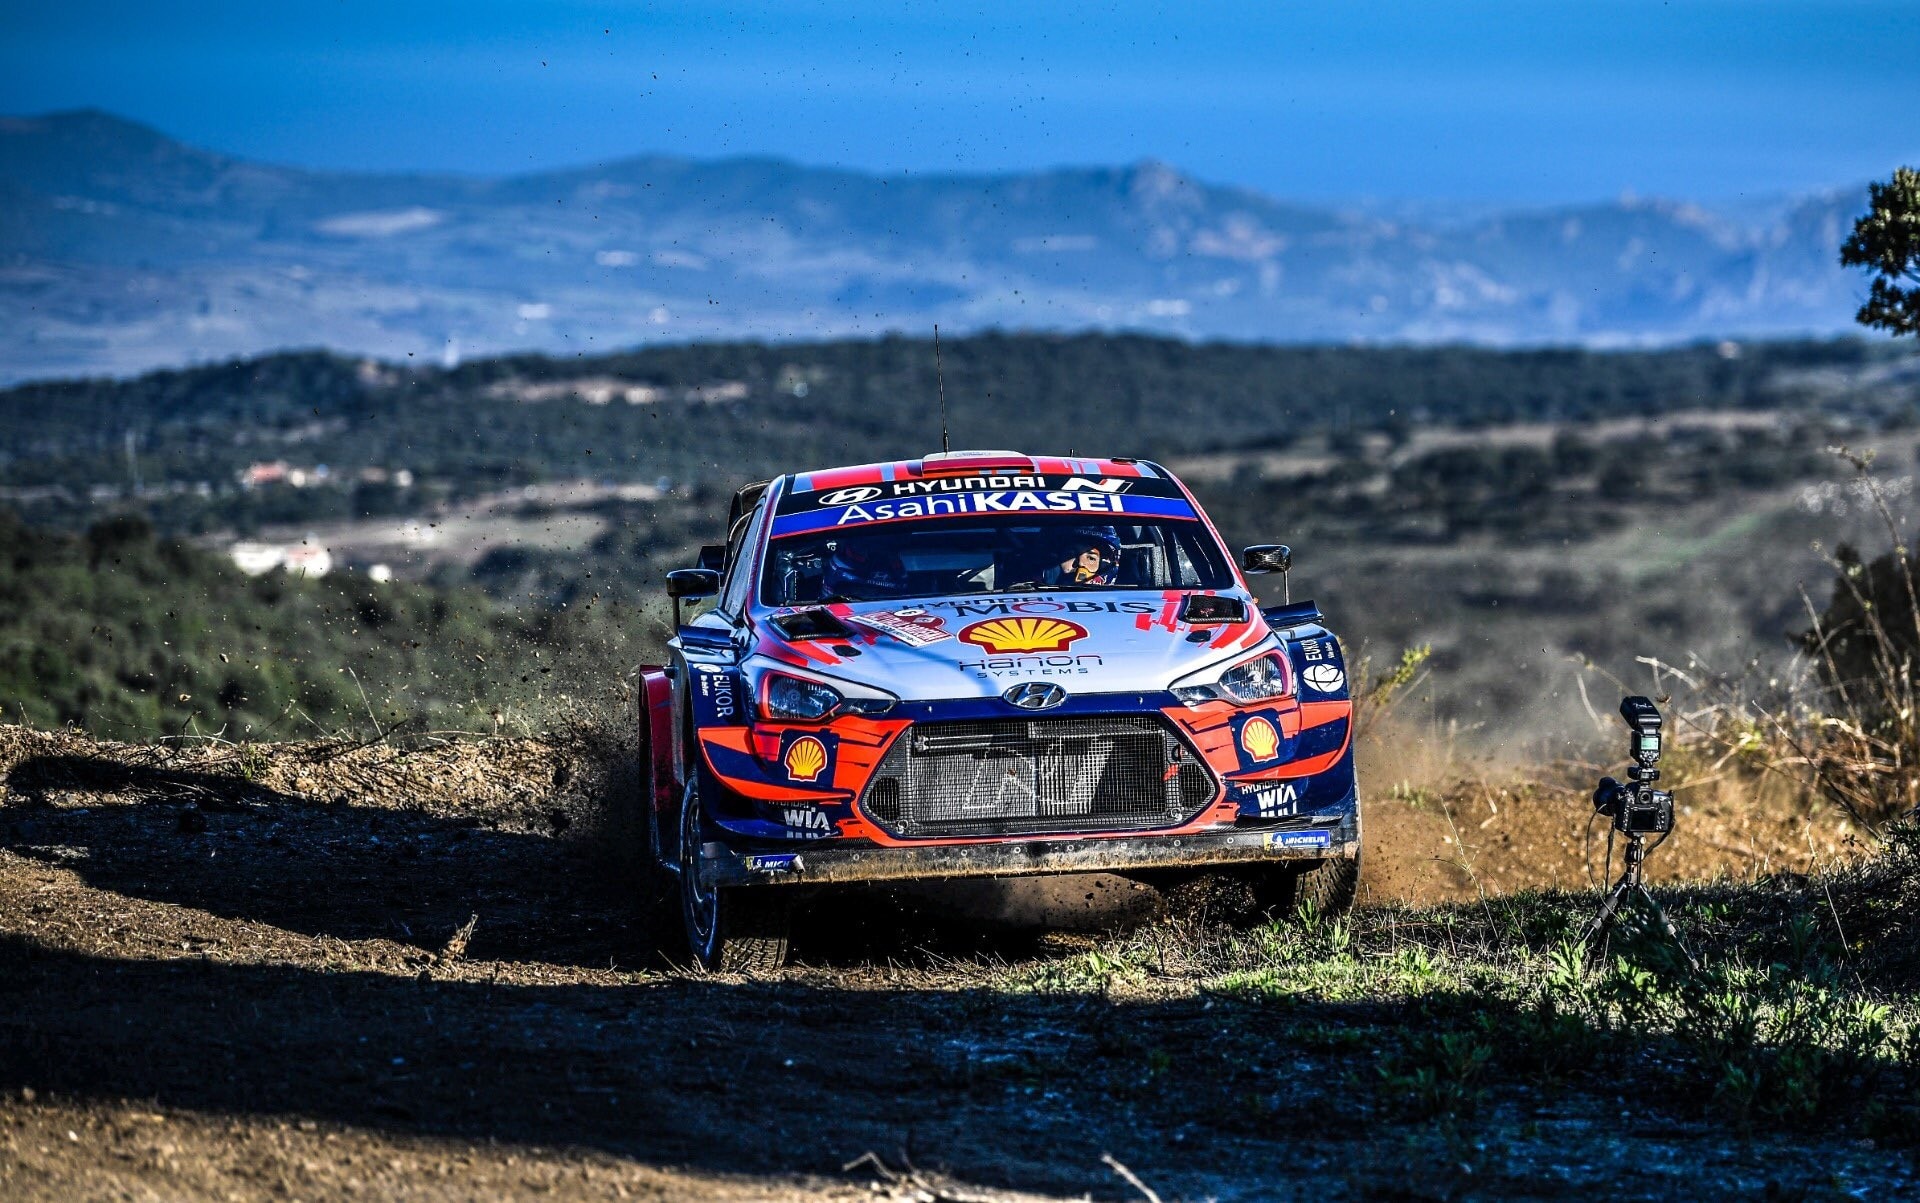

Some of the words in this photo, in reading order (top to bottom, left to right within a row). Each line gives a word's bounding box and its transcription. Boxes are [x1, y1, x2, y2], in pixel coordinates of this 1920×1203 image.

[893, 476, 1046, 495] HYUNDAI
[902, 596, 1054, 610] HYUNDAI
[954, 601, 1157, 617] MOBIS
[977, 668, 1089, 679] SYSTEMS
[712, 674, 734, 718] EUKOR
[1256, 784, 1297, 818] WIA
[783, 807, 831, 838] WIA
[1285, 836, 1326, 844] MICHELIN
